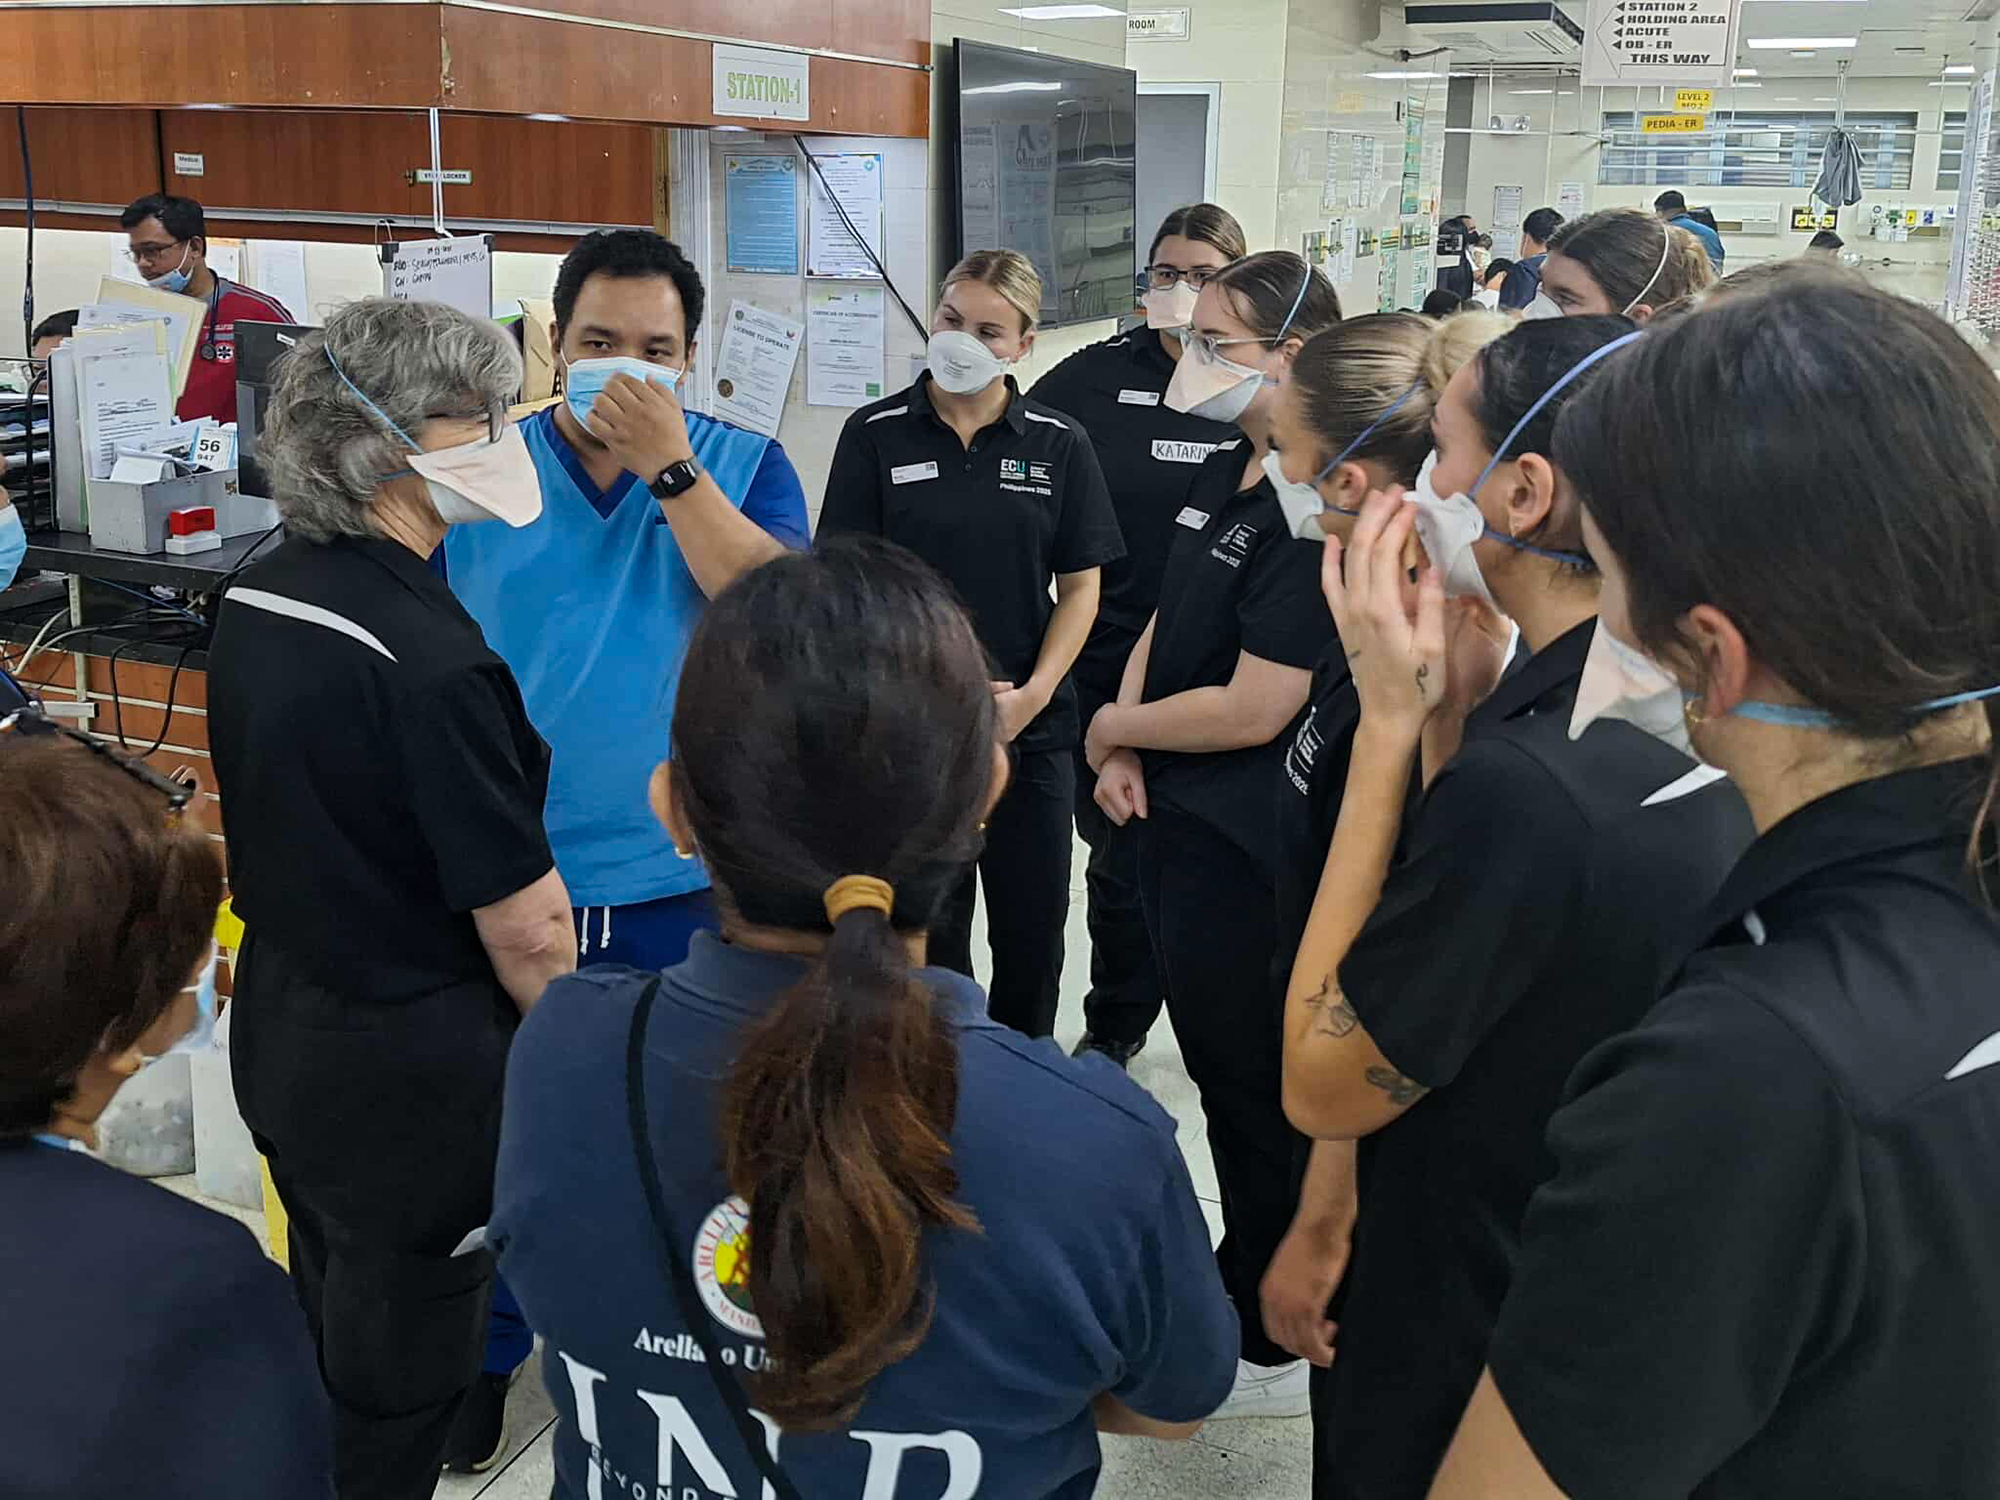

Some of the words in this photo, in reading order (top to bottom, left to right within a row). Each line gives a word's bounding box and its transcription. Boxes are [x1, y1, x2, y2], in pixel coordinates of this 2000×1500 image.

[1628, 2, 1686, 11] STATION
[1689, 3, 1698, 11] 2
[1129, 19, 1156, 30] ROOM
[1627, 15, 1688, 24] HOLDING
[1691, 15, 1726, 24] AREA
[1625, 28, 1671, 36] ACUTE
[1625, 40, 1644, 49] OB
[1656, 40, 1673, 49] ER
[1630, 53, 1669, 64] THIS
[1673, 53, 1711, 64] WAY
[727, 71, 801, 104] STATION-1
[1678, 93, 1702, 101] LEVEL
[1703, 93, 1710, 101] 2
[1647, 120, 1676, 129] PEDIA
[1685, 119, 1697, 128] ER
[199, 439, 221, 452] 56
[1001, 458, 1025, 472] ECU
[1000, 483, 1035, 493] Philippines
[634, 1327, 737, 1366] Arellao
